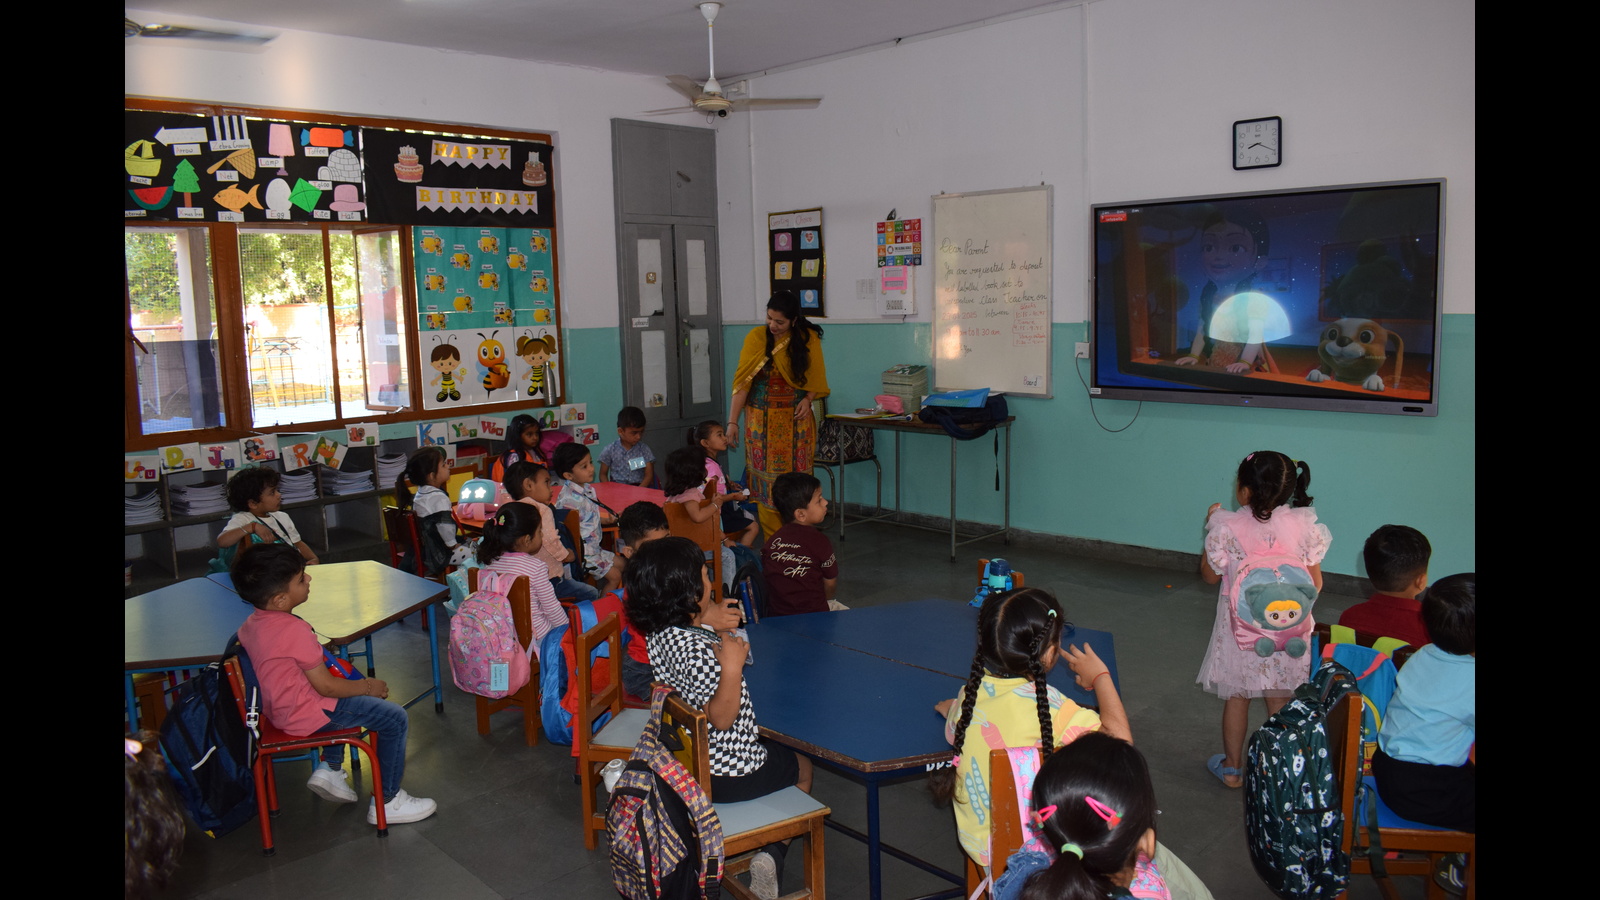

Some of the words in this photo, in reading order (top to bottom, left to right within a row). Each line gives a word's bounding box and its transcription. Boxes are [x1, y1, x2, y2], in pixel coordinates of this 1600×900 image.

[433, 143, 509, 160] HAPPY
[260, 159, 279, 167] Lamp
[418, 189, 536, 206] BIRTHDAY
[220, 213, 234, 221] Fish
[270, 210, 285, 219] Egg
[940, 237, 962, 254] Dear
[965, 239, 989, 255] Parent
[957, 267, 967, 275] are
[969, 262, 1004, 278] requested
[1009, 260, 1016, 271] to
[1020, 258, 1043, 274] deposit
[984, 279, 1000, 290] book
[1014, 276, 1023, 288] to
[985, 309, 1010, 318] between
[1023, 376, 1038, 386] Board
[452, 422, 464, 437] Y
[481, 421, 497, 434] W
[419, 423, 435, 447] K
[582, 428, 594, 445] Z
[166, 447, 184, 468] P
[208, 446, 224, 466] J
[292, 443, 309, 467] R
[770, 537, 801, 550] Superior
[770, 551, 812, 564] Authentic
[783, 565, 810, 578] Art
